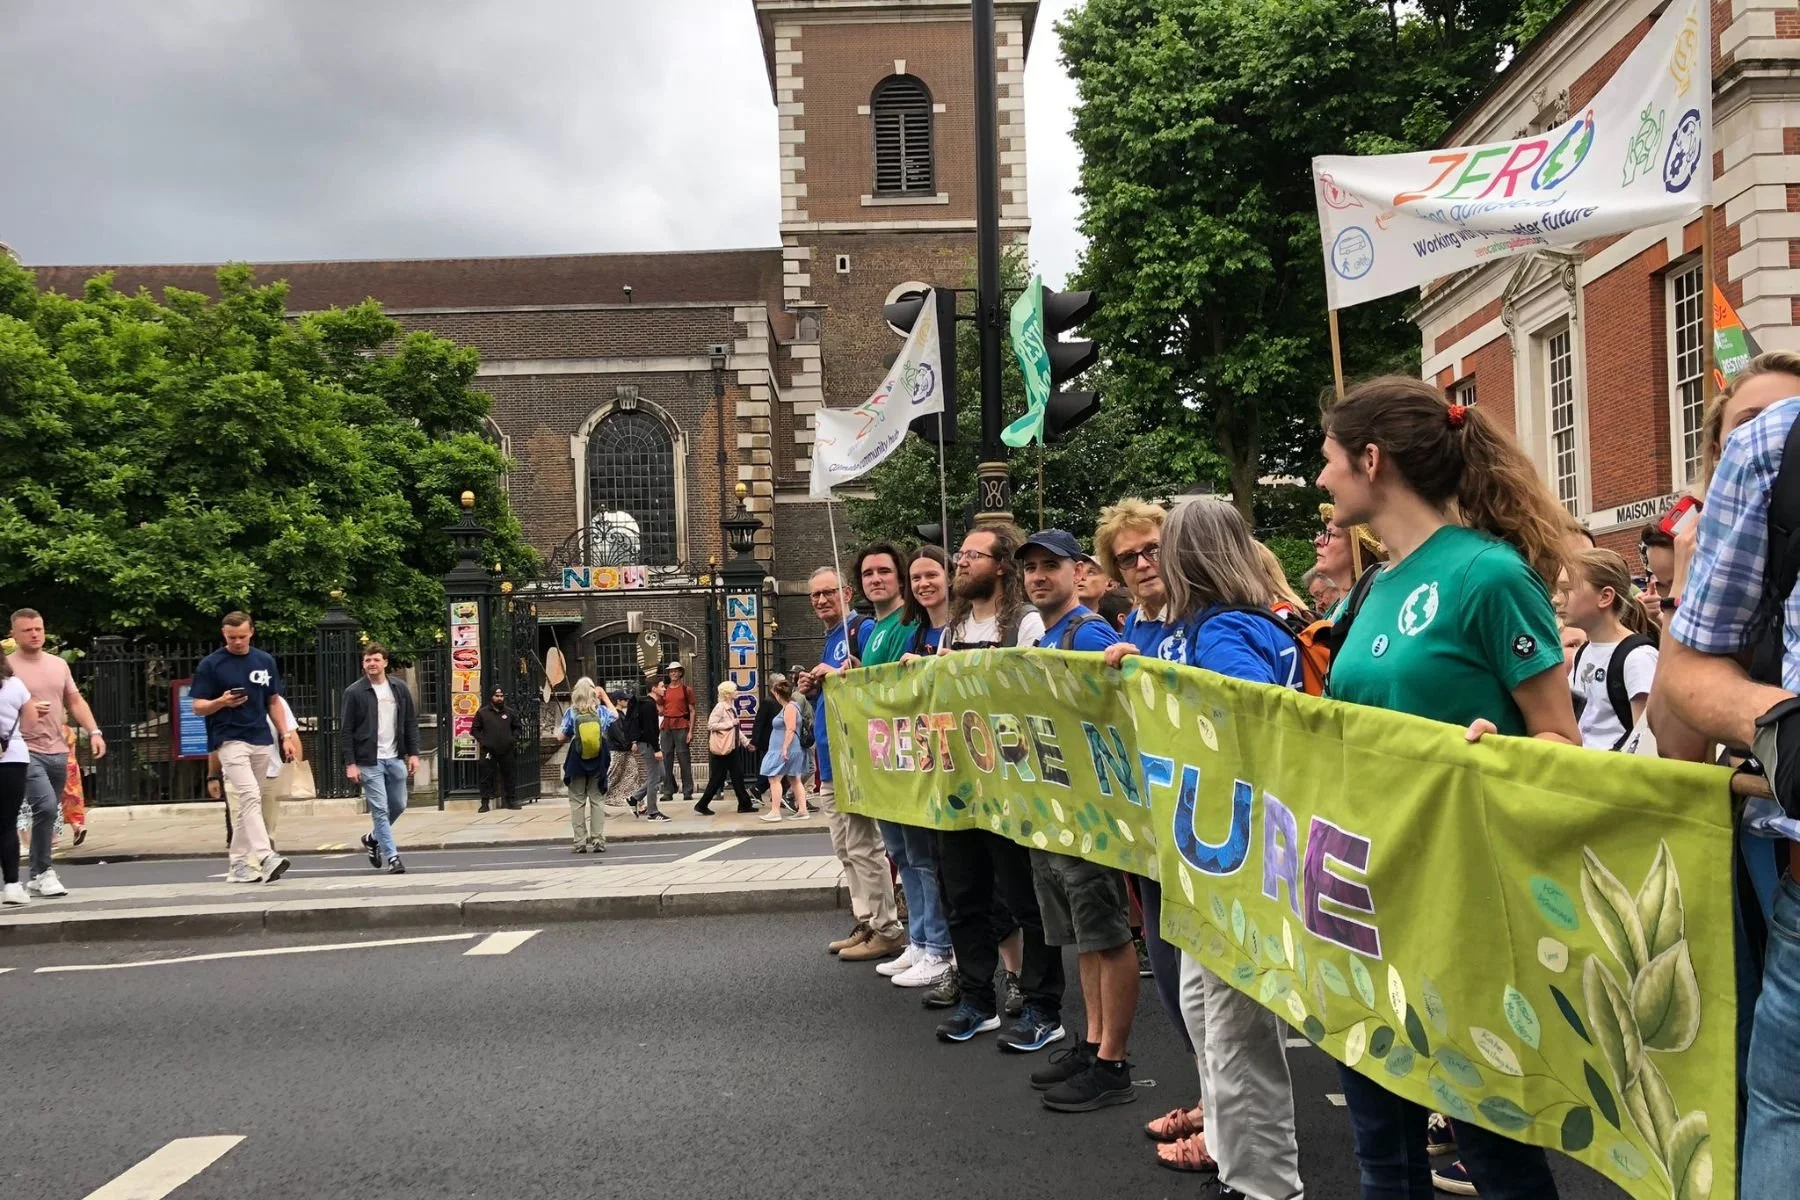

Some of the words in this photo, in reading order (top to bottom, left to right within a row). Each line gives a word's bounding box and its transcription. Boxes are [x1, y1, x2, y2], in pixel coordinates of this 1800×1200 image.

[1393, 111, 1595, 206] ZERO
[1413, 232, 1461, 257] Working
[1542, 205, 1599, 231] future
[1617, 500, 1656, 524] MAISON
[563, 566, 646, 590] NOW
[868, 709, 1071, 788] RESTORE
[1081, 721, 1382, 960] NTURE
